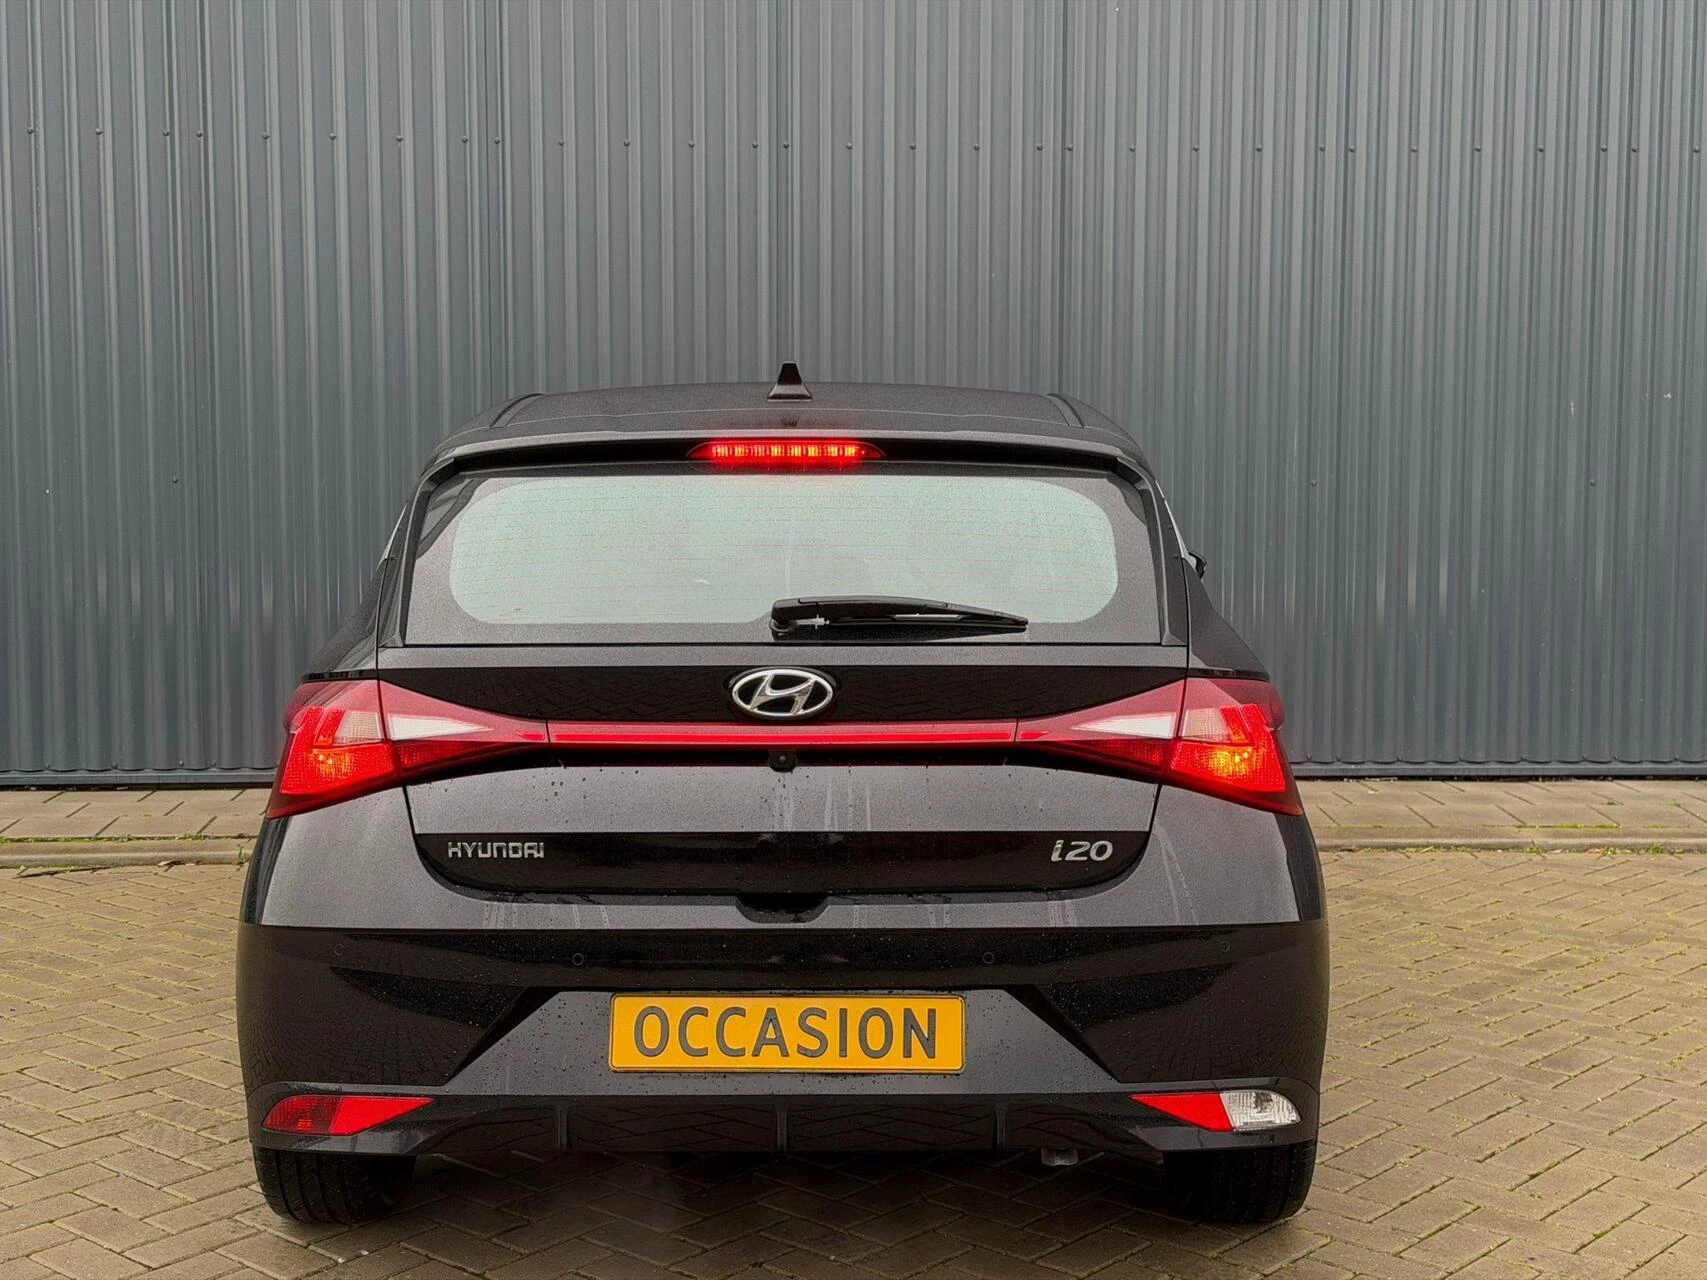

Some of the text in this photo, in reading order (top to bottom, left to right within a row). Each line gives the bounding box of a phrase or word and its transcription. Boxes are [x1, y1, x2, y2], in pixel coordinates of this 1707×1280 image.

[447, 841, 545, 859] HYUNDAI
[1050, 839, 1114, 862] i20
[633, 1005, 937, 1060] OCCASION
